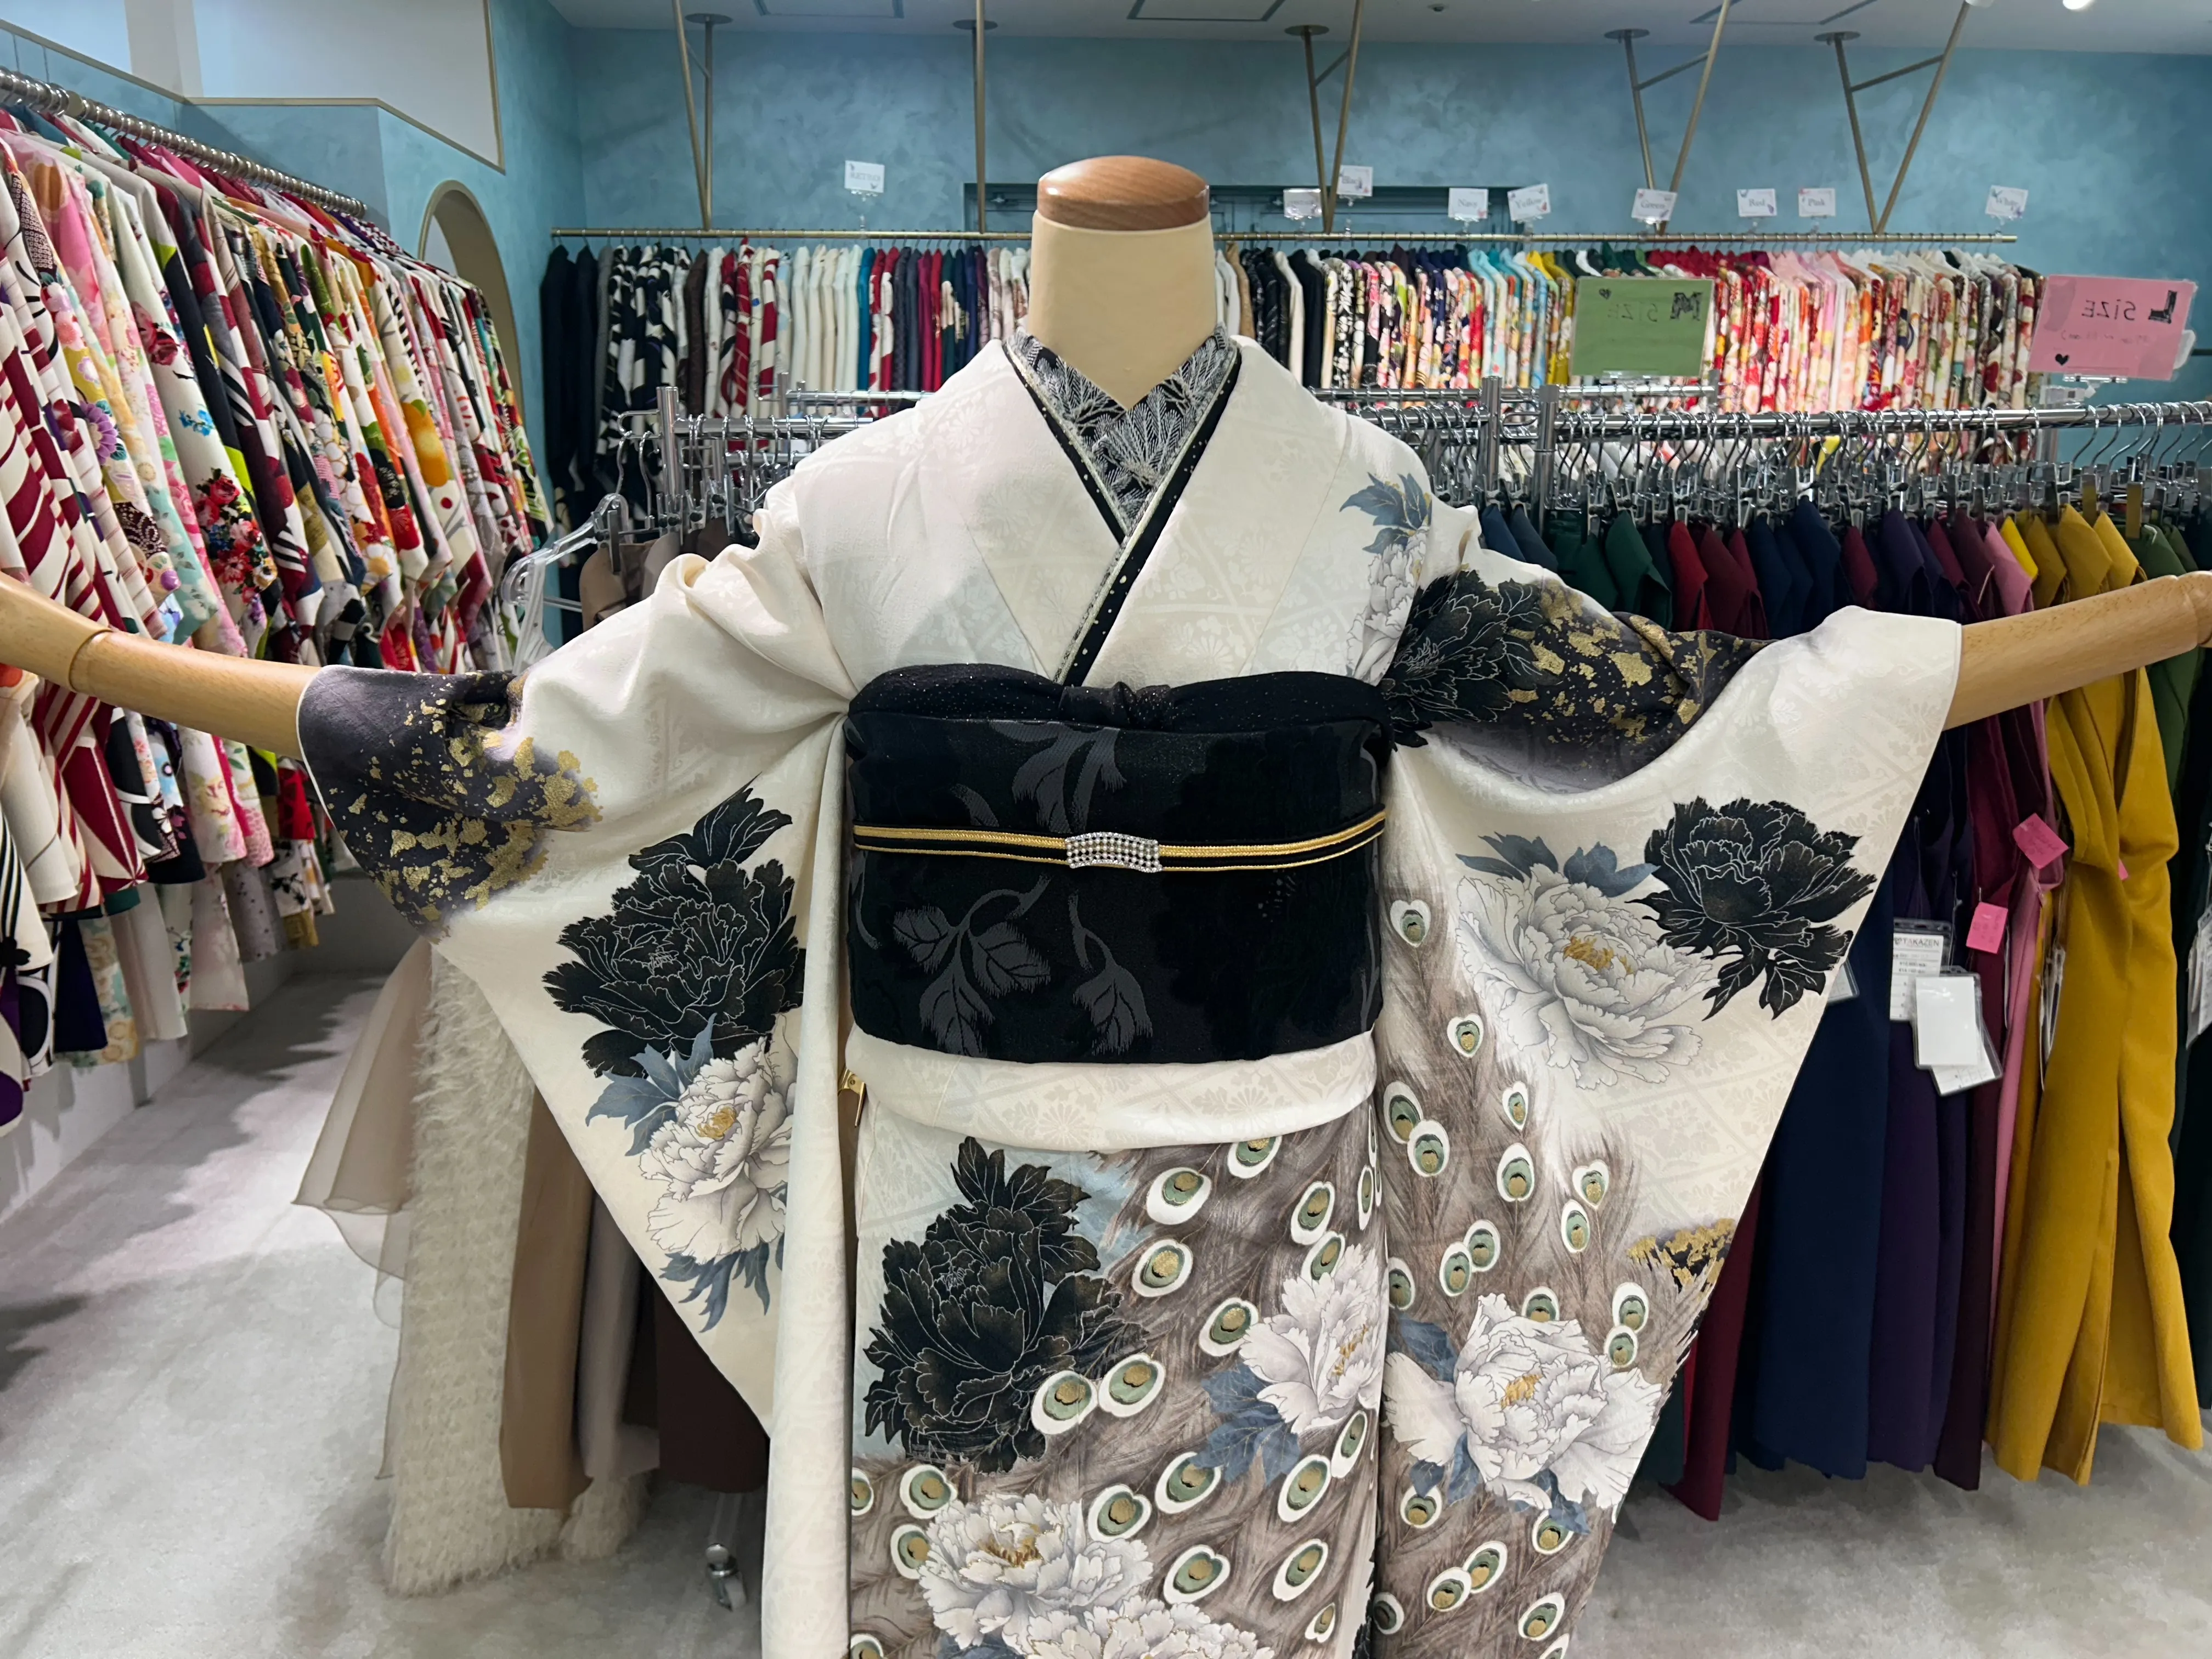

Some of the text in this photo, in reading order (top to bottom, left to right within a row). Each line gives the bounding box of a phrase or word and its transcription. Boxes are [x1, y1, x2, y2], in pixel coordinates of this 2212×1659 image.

[1458, 198, 1477, 208] Navy
[1516, 197, 1542, 209] Yellow
[1641, 199, 1666, 208] Green
[1749, 198, 1765, 207] Red
[1808, 198, 1825, 206] Pink
